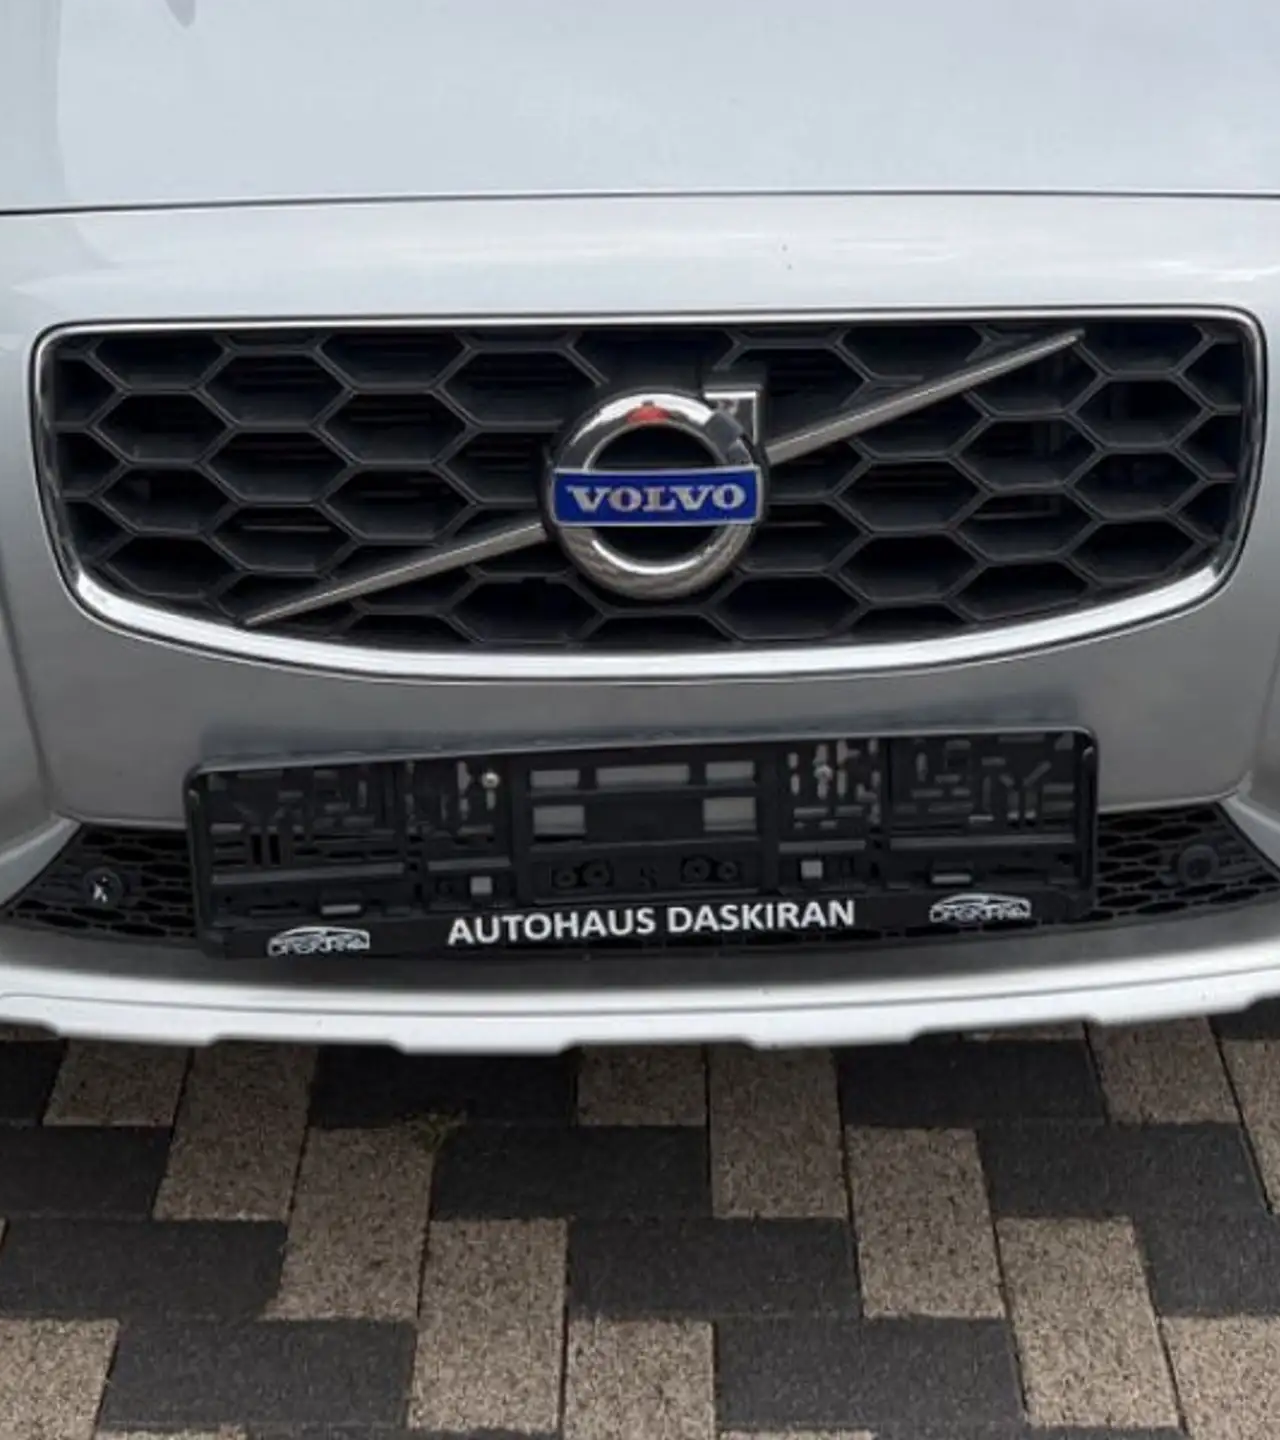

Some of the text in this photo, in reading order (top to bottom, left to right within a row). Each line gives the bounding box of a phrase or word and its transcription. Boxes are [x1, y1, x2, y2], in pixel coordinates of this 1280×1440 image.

[565, 483, 746, 513] VOLVO
[447, 900, 855, 946] AUTOHAUS DASKIRAN
